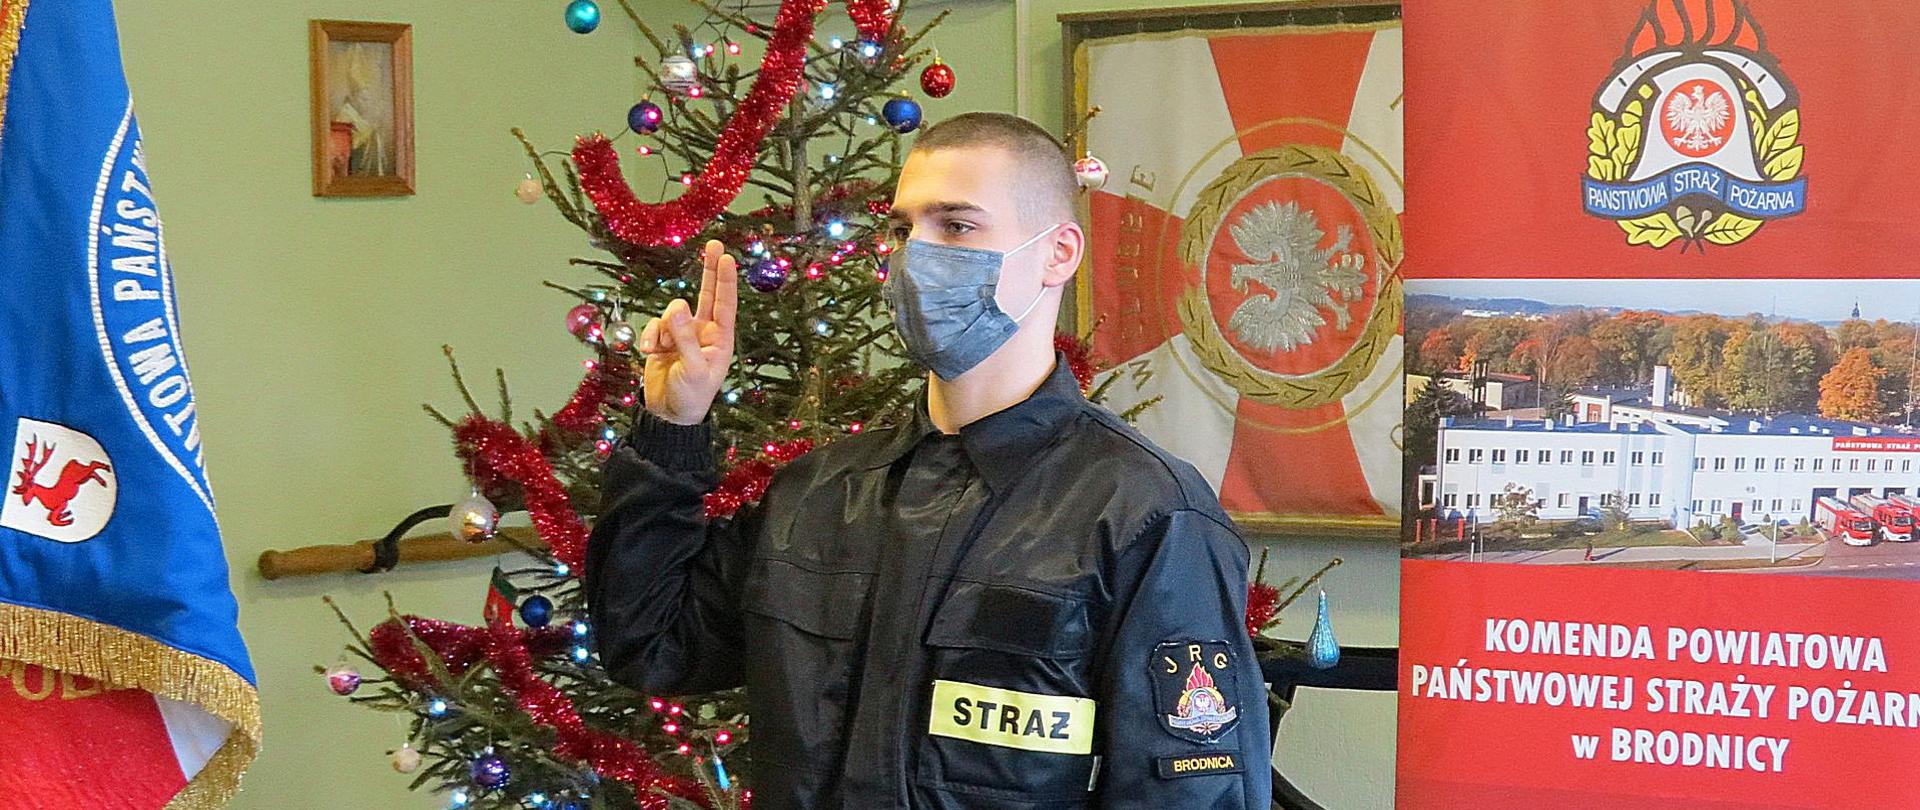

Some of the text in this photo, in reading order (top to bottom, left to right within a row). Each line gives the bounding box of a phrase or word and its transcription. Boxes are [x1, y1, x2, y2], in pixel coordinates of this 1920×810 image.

[1588, 169, 1795, 211] PAŃSTWOWA STRAŻ POŻARNA
[1485, 618, 1888, 673] KOMENDA POWIATOWA
[1411, 658, 1633, 711] PAŃSTWOWEJ
[1646, 674, 1775, 719] STRAŻY
[1173, 755, 1235, 772] BRODNICA
[1571, 727, 1791, 772] w BRODNICY
